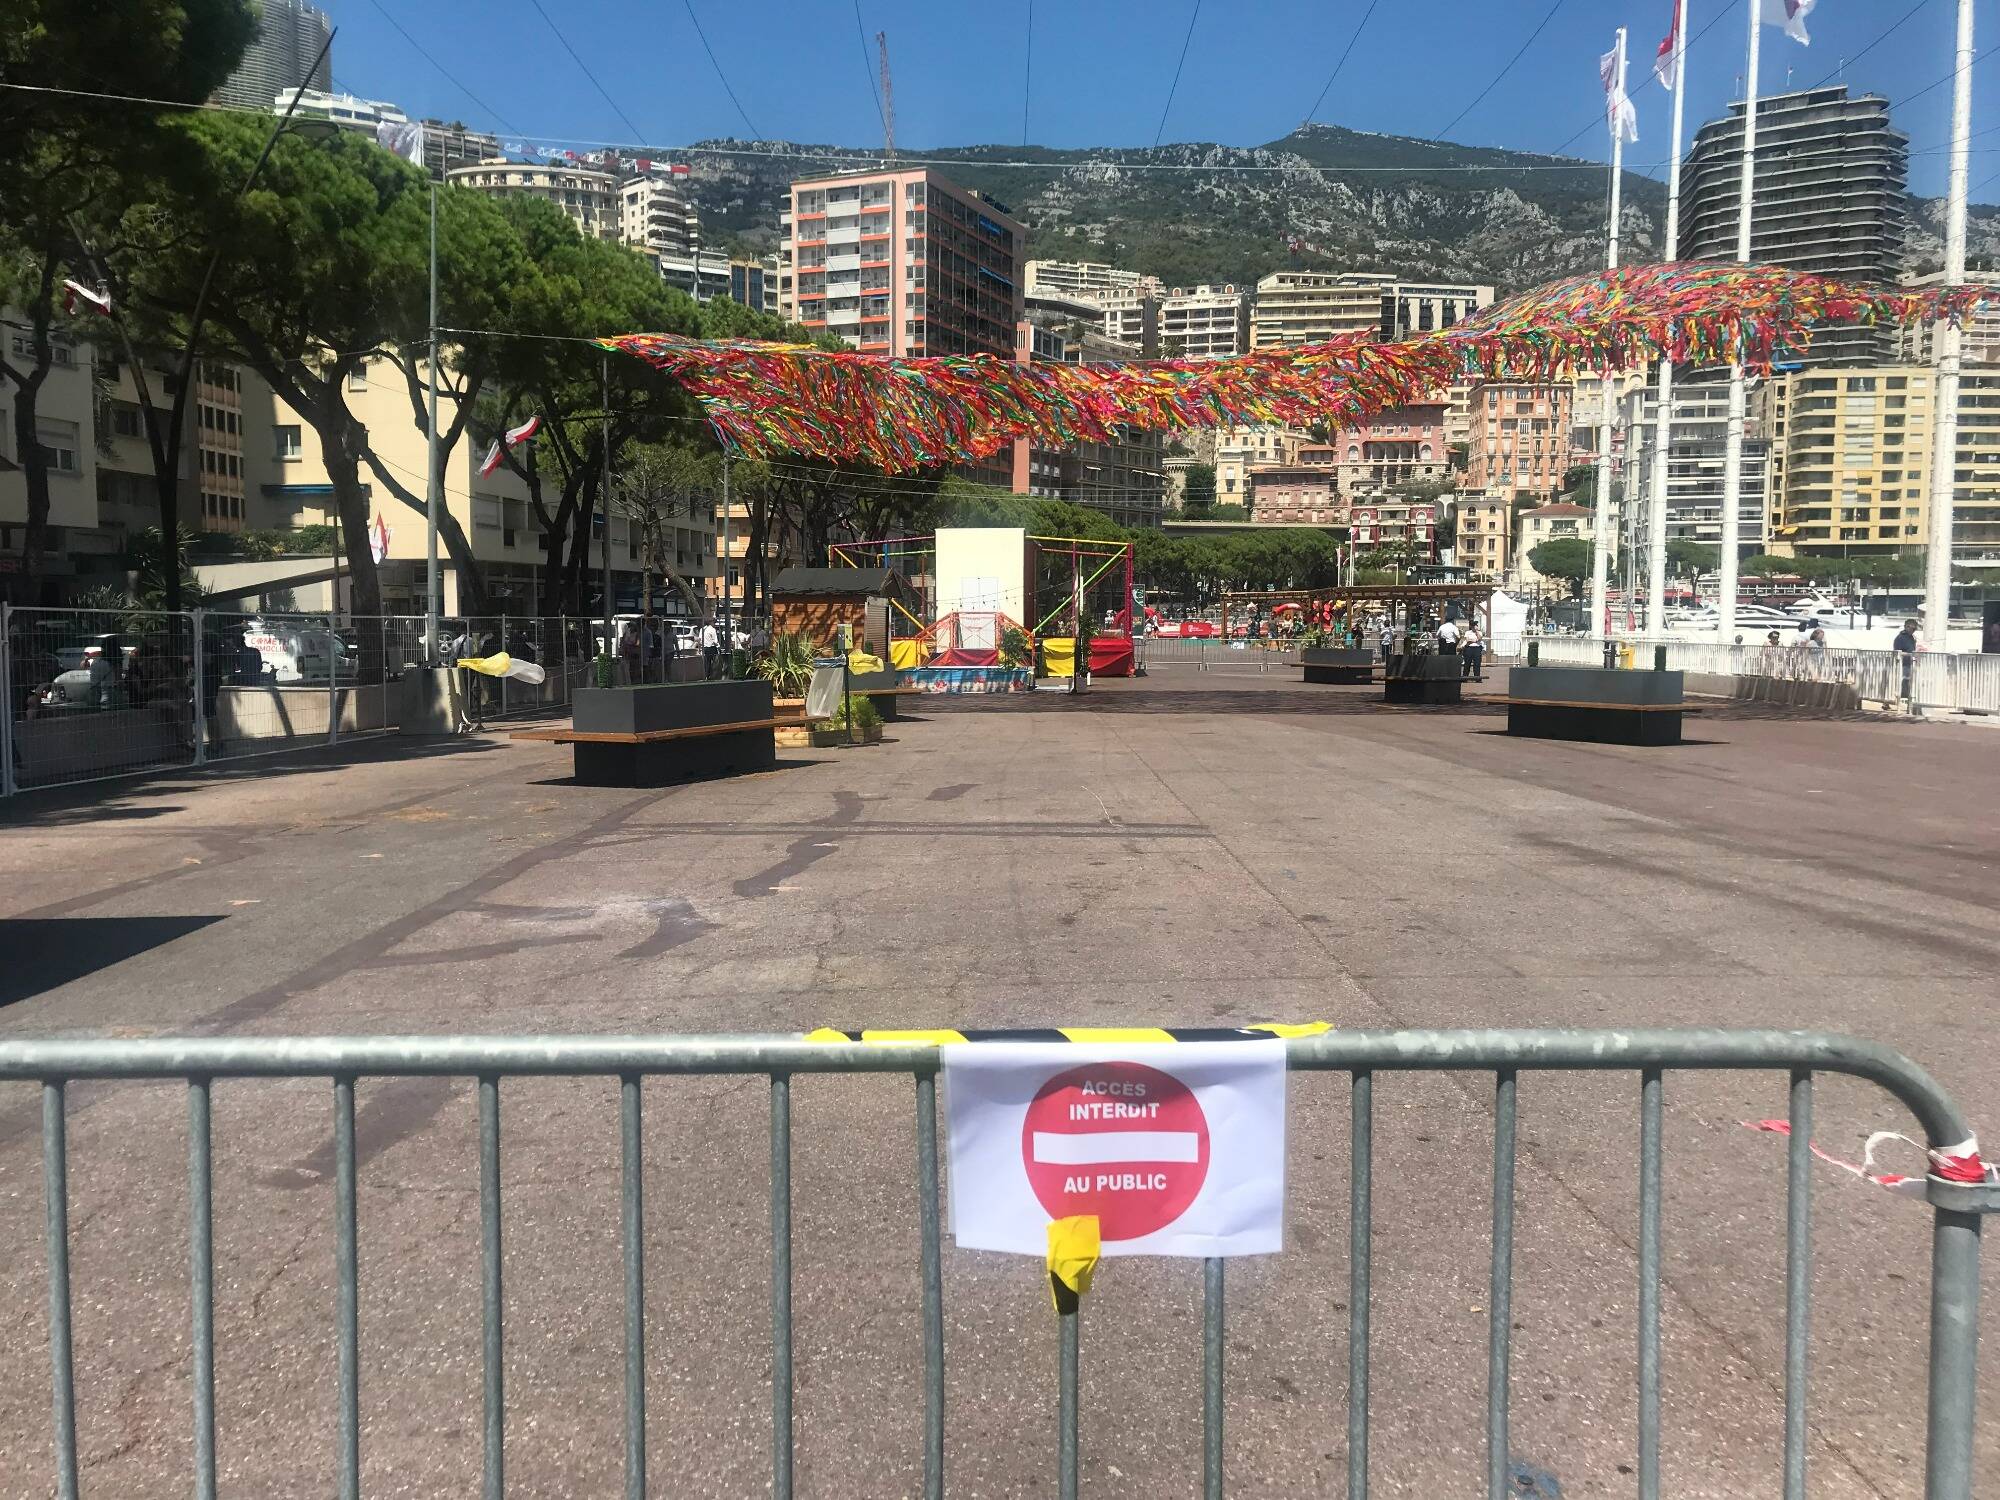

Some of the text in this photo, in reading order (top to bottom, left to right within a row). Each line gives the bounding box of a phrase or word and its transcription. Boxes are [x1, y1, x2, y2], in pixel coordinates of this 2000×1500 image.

[1082, 1080, 1147, 1097] ACCÈS
[1069, 1102, 1160, 1121] INTERDIT
[1063, 1173, 1167, 1194] AU PUBLIC
